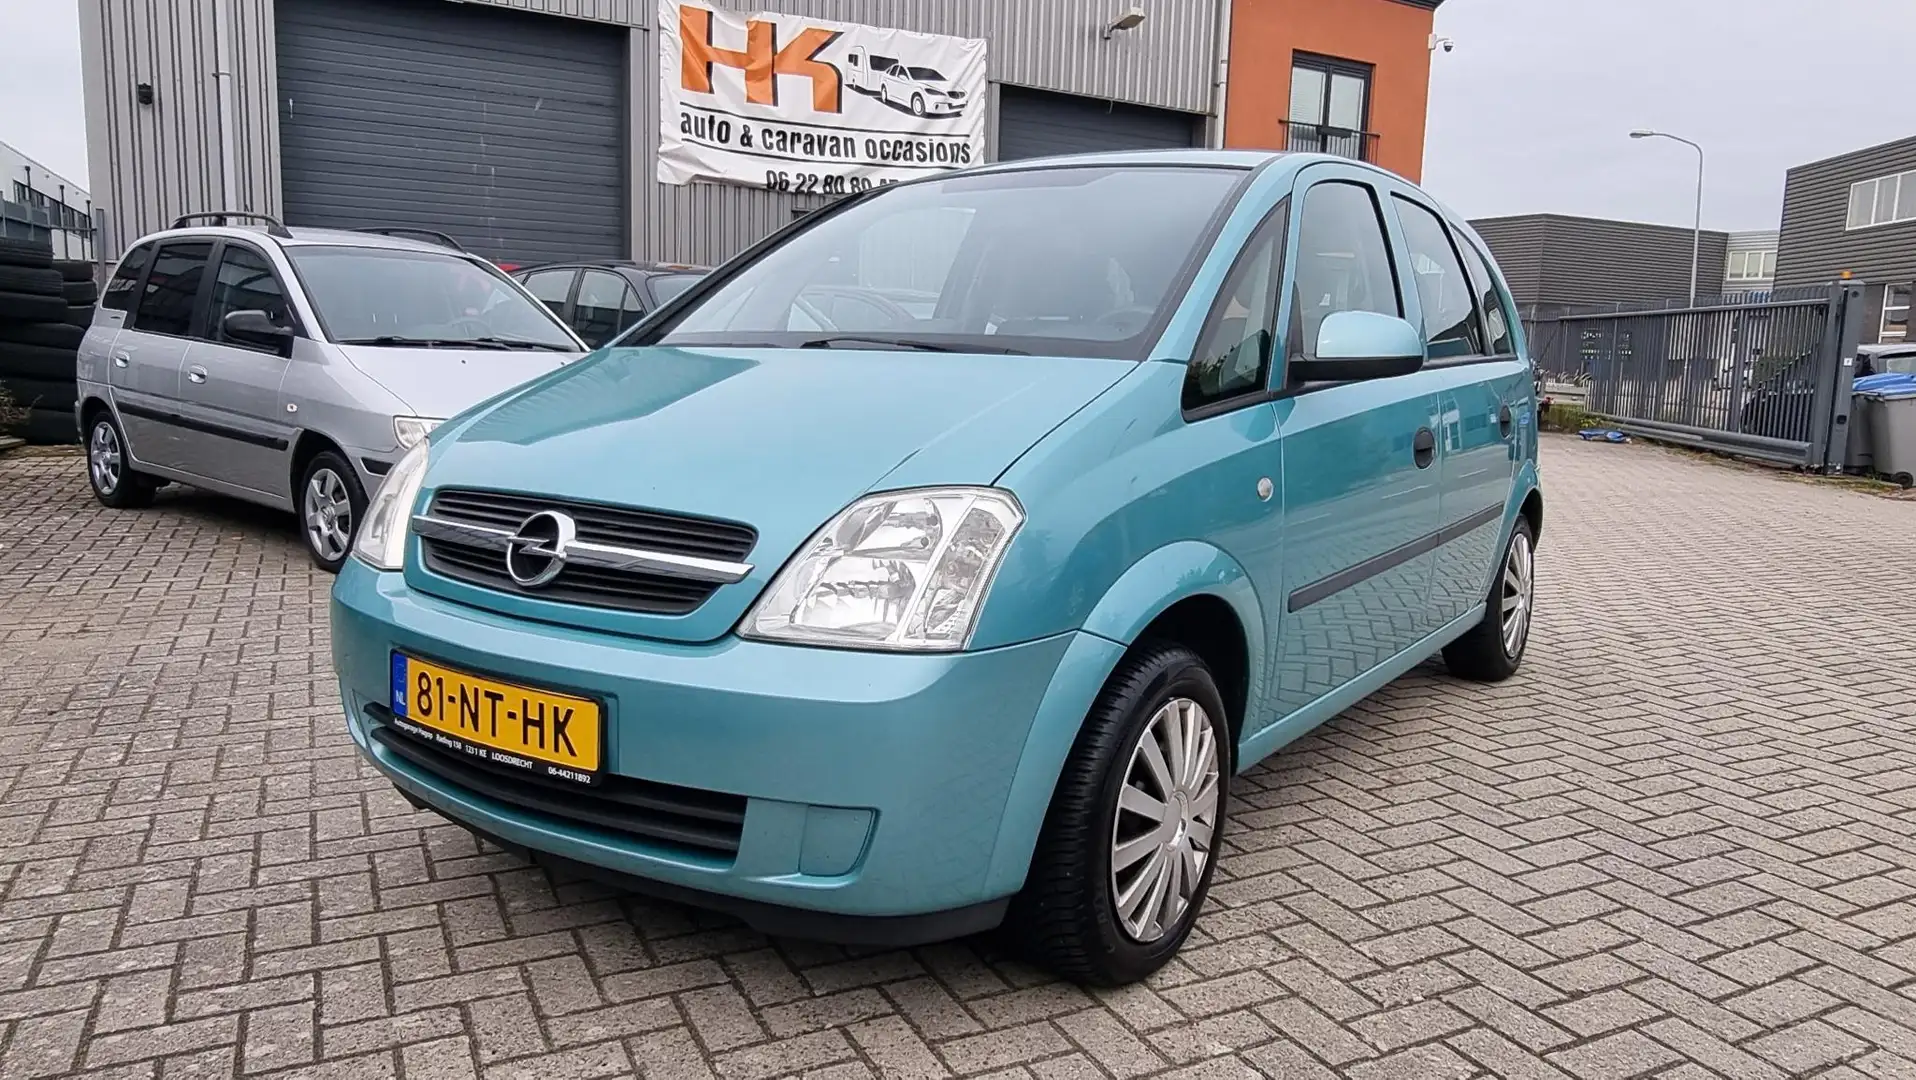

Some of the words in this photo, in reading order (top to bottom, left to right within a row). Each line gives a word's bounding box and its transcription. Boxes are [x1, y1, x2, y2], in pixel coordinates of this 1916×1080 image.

[680, 4, 845, 114] HK
[680, 112, 731, 144] auto
[740, 124, 753, 148] &
[761, 128, 856, 158] caravan
[864, 138, 971, 164] occasions
[766, 170, 790, 191] 06
[795, 173, 818, 196] 22
[823, 175, 845, 195] 80
[395, 690, 406, 706] NL
[417, 671, 578, 757] 81-NT-HK
[491, 752, 533, 769] LOOSDRECHT
[547, 766, 591, 784] 06-44211892
